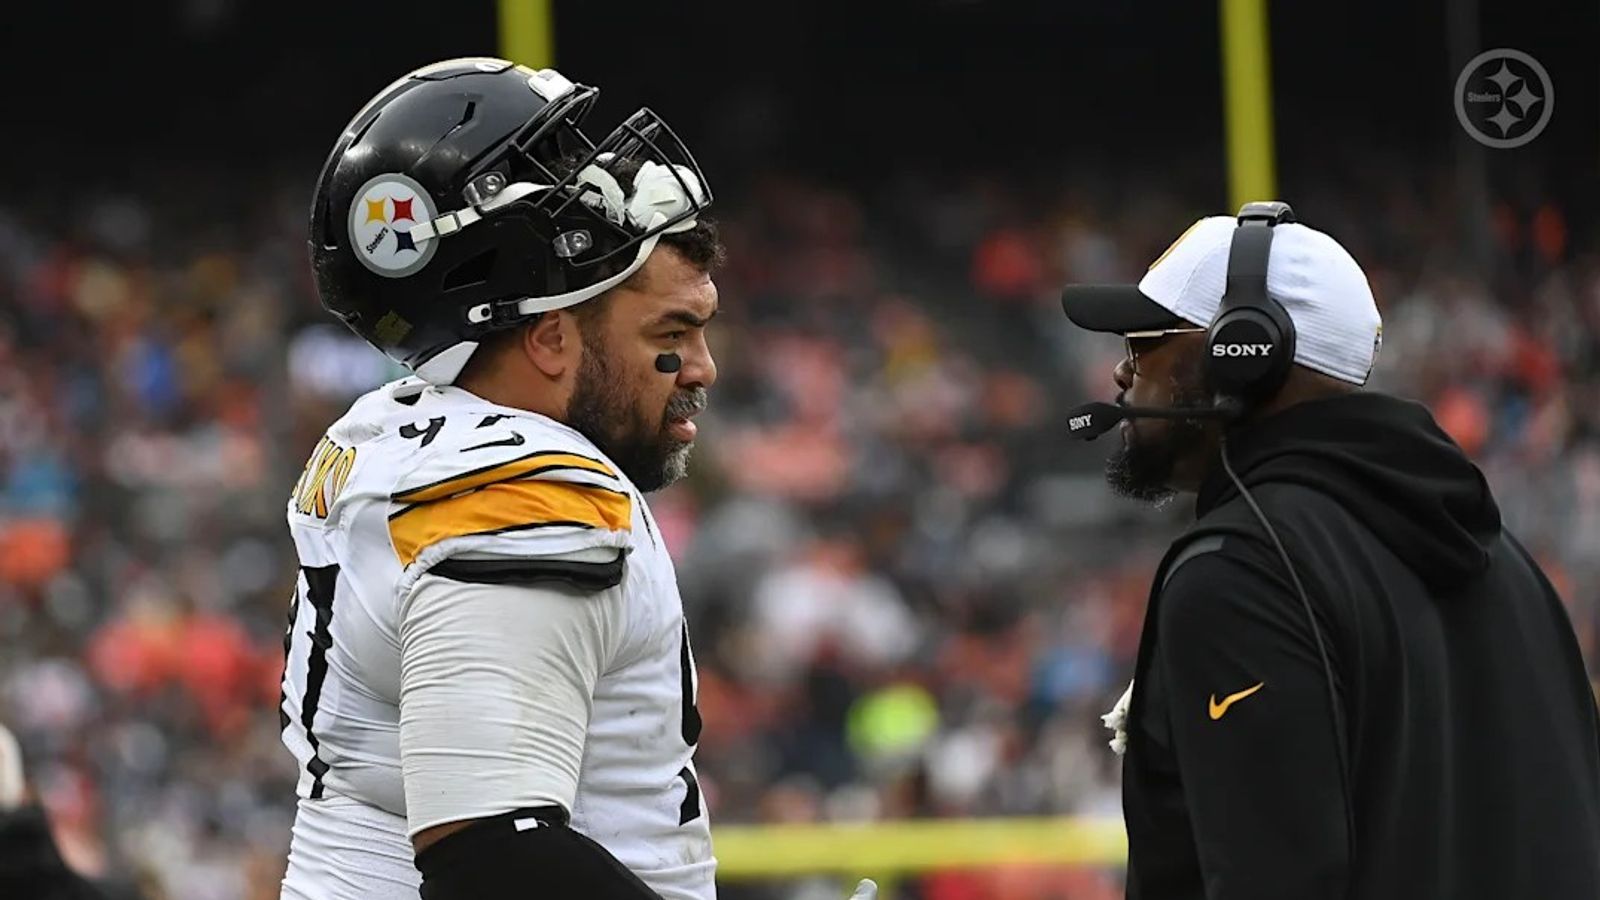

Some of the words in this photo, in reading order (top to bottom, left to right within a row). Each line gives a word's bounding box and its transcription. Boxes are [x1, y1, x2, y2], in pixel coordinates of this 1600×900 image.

[366, 227, 388, 254] Steelers
[1213, 344, 1273, 356] SONY
[1069, 413, 1092, 430] SONY
